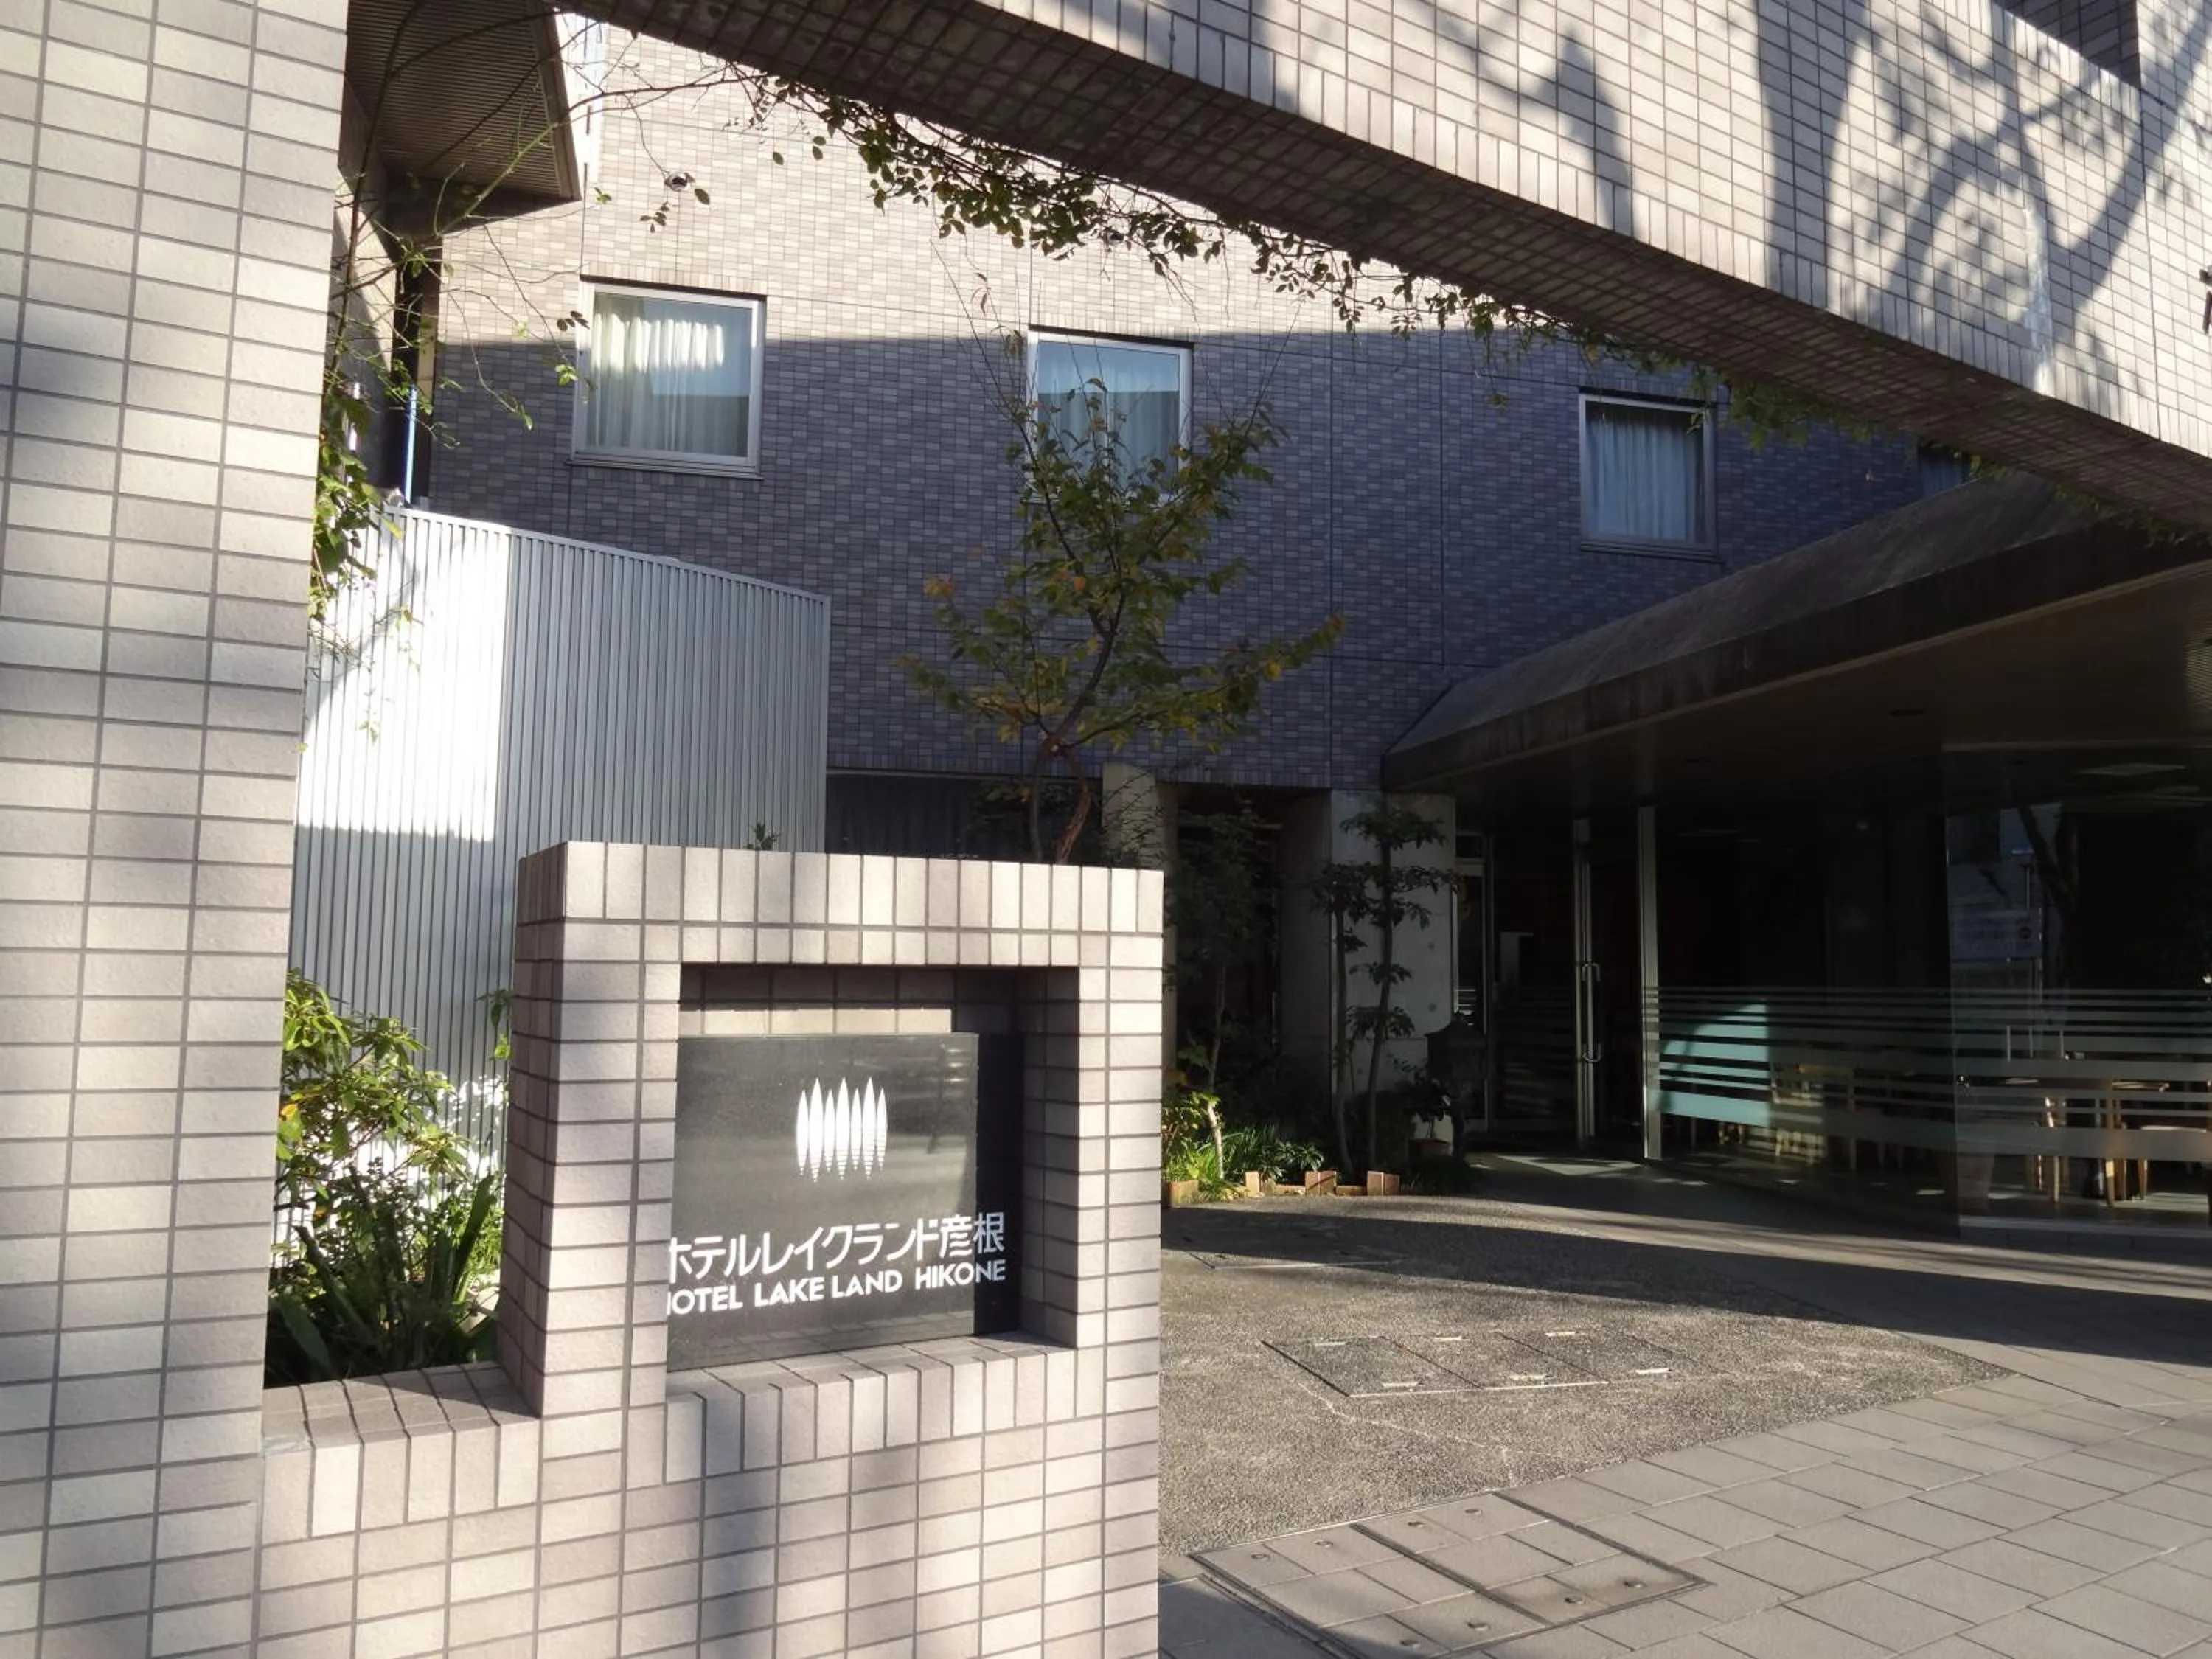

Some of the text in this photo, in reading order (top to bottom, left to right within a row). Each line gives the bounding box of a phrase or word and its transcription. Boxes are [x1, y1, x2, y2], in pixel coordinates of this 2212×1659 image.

[754, 1276, 824, 1307] LAKE
[832, 1270, 903, 1299] LAND
[915, 1259, 1006, 1289] HIKONE
